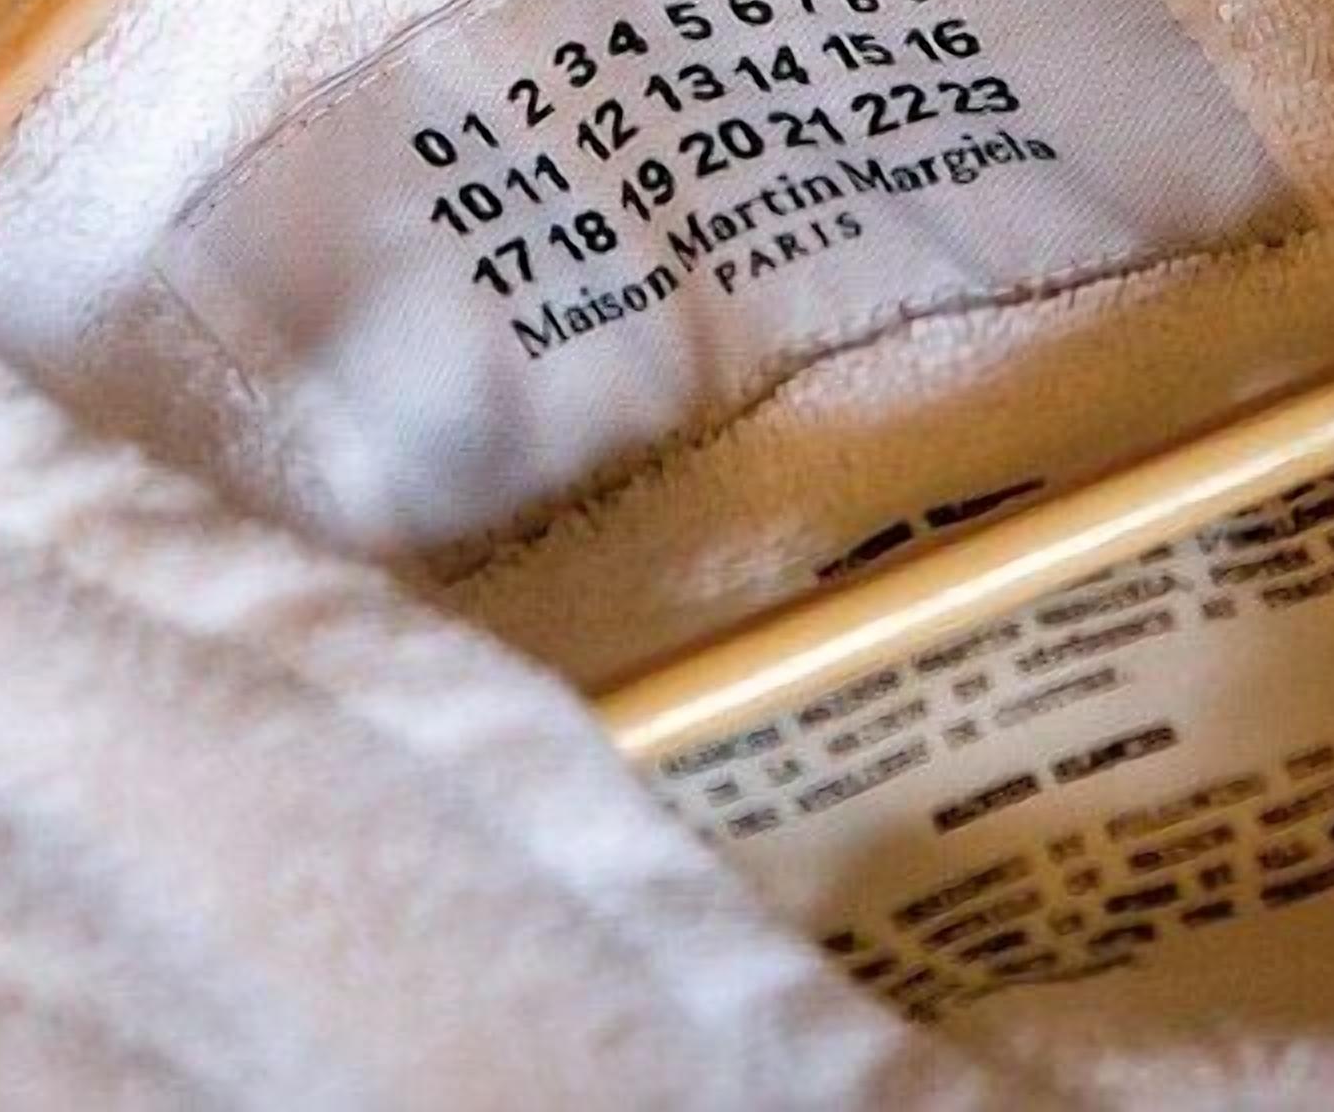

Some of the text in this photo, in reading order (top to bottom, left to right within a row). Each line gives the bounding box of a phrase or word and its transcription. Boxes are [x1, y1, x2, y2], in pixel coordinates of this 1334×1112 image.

[412, 128, 457, 167] 0
[463, 112, 499, 147] 1
[506, 79, 554, 127] 2
[554, 42, 598, 87] 3
[608, 20, 648, 61] 4
[665, 2, 712, 42] 5
[430, 18, 980, 235] 10 11 12 13 14 15 16
[472, 75, 1019, 296] 17 18 19 20 21 22 23
[511, 129, 1057, 359] Maison Martin Margiela
[713, 211, 863, 294] PARIS
